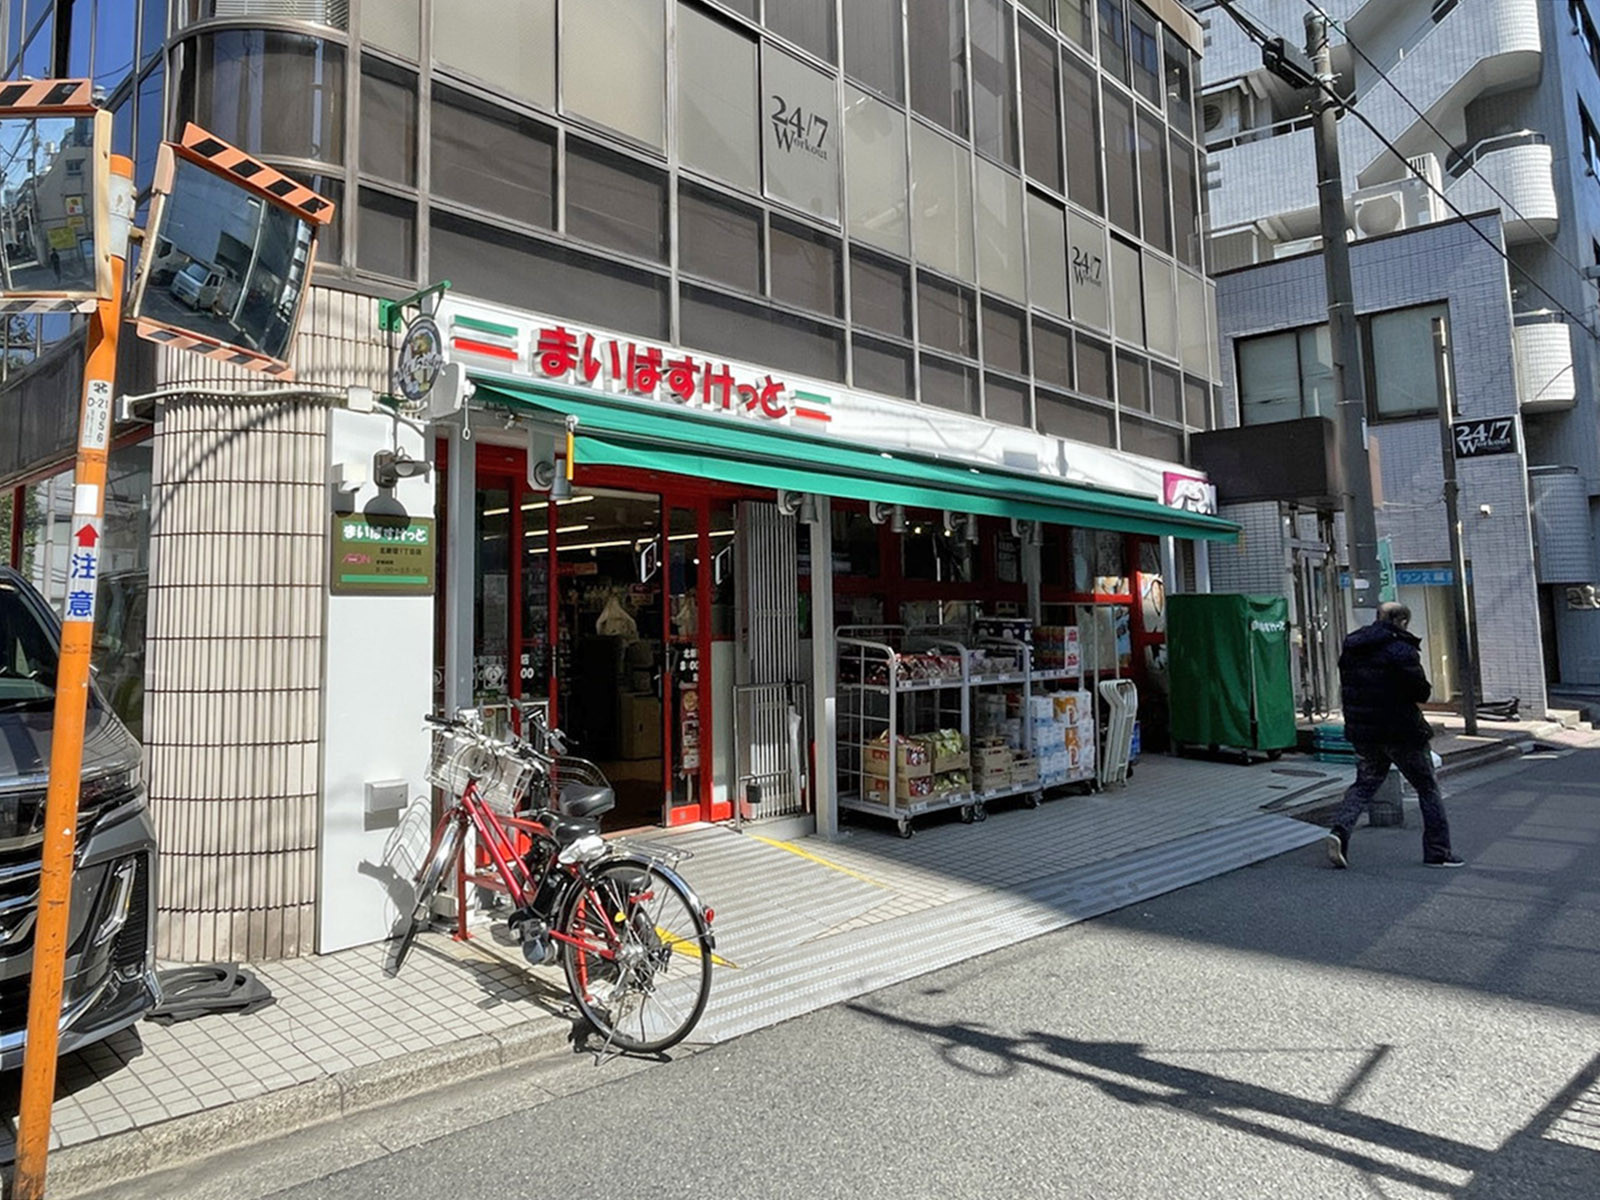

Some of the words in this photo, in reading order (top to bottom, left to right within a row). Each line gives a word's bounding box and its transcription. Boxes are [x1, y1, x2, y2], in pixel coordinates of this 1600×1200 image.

[771, 95, 828, 147] 24/7
[772, 121, 827, 160] Workout
[1071, 246, 1102, 279] 24/7
[535, 326, 788, 420] まいばすけっと
[1456, 421, 1512, 442] 24/7
[343, 524, 427, 543] まいばすけっと
[67, 552, 97, 617] 注意
